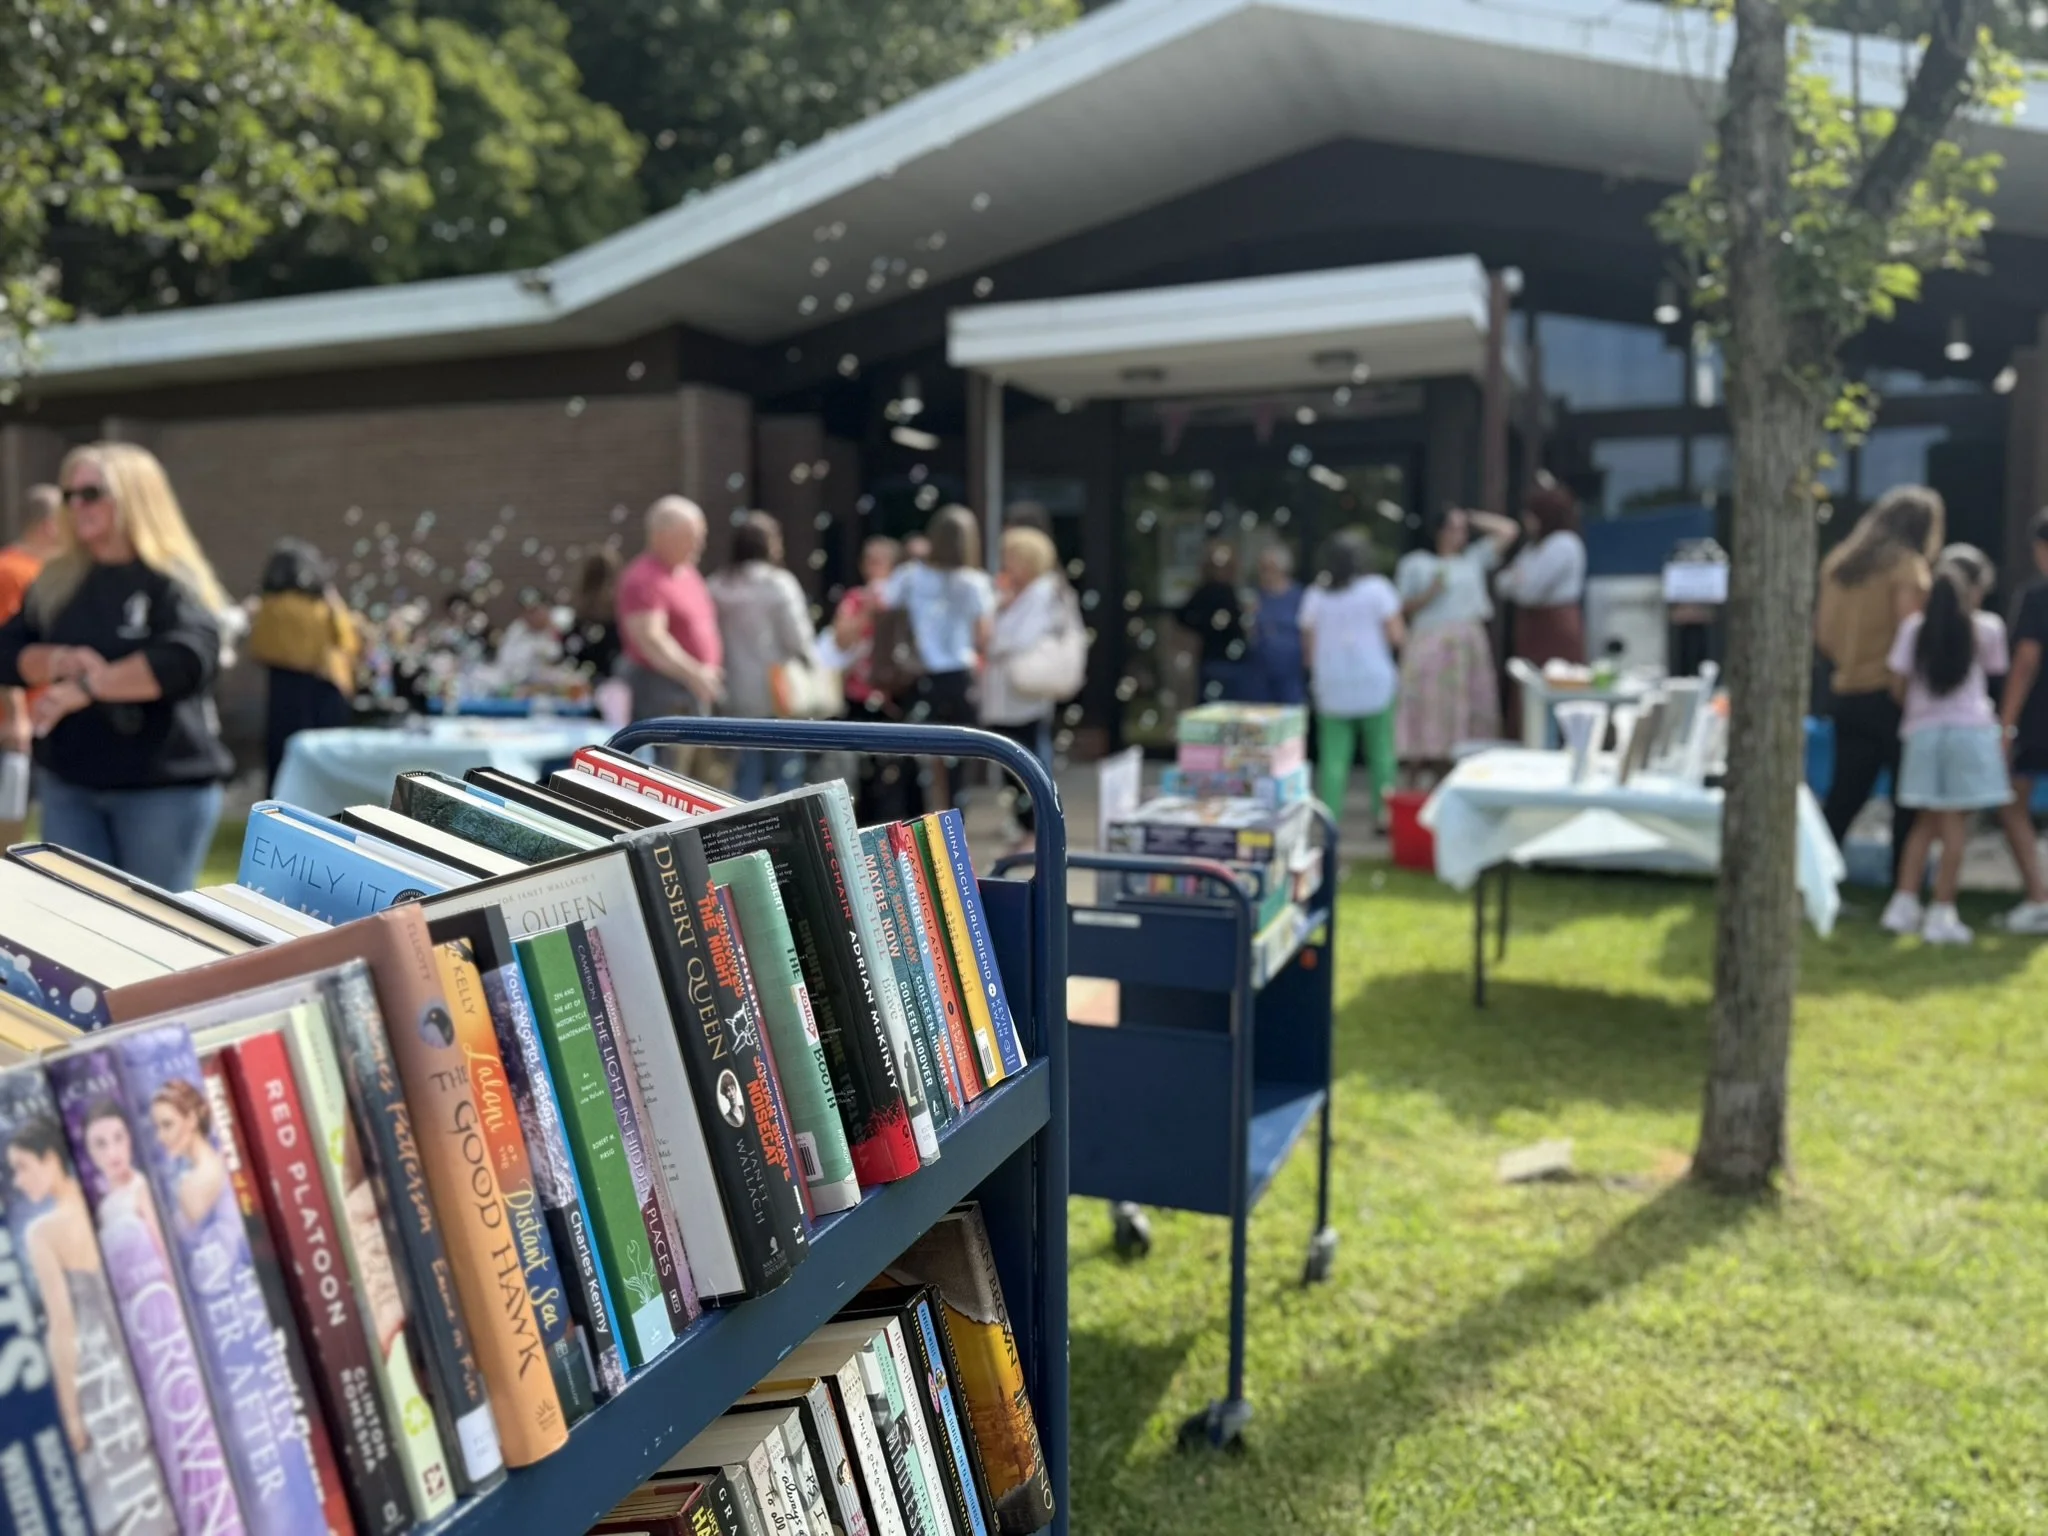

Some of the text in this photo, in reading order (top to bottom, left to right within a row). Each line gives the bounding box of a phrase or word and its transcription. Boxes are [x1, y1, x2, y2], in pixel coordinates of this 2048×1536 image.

[251, 835, 346, 894] EMILY
[706, 880, 718, 908] WE
[764, 861, 785, 912] COLBERT
[819, 817, 852, 921] THE CHAIN
[838, 797, 888, 961] DANIELLE STEEL
[864, 853, 888, 913] MAYBE
[882, 918, 901, 958] NOW
[878, 839, 898, 889] MAYBE
[891, 895, 919, 965] SOMEDAY
[900, 851, 925, 936] NOVEMBER
[944, 815, 992, 981] CHINA RICH GIRLFRIEND
[407, 921, 431, 982] ELLIOTT
[523, 892, 608, 934] QUEEN
[653, 846, 729, 1061] DESERT QUEEN
[697, 895, 732, 988] THE NIGHT
[904, 833, 949, 994] CRAZY RICH ASIANS
[454, 966, 476, 1015] KELLY
[506, 962, 528, 1012] Your
[563, 988, 575, 997] AND
[565, 1003, 574, 1012] ART
[578, 945, 597, 1001] CAMERON
[849, 930, 873, 1004] ADRIAN
[871, 1009, 899, 1089] McKINTY
[882, 978, 898, 1021] Brave
[990, 1001, 1004, 1038] KWAN
[995, 998, 1009, 1036] KEVIN
[556, 1012, 587, 1028] MOTORCYCLE
[558, 1024, 591, 1041] MAINTENANCE
[787, 947, 801, 981] THE
[812, 1048, 837, 1110] BOOTH
[899, 981, 934, 1088] COLLEEN HOOVER
[915, 975, 950, 1085] COLLEEN HOOVER
[928, 972, 955, 1074] COLLEEN HOOVER
[950, 1023, 966, 1062] KWAN
[954, 1021, 968, 1060] KEVIN
[204, 1074, 242, 1172] Killers
[429, 1065, 468, 1092] THE
[463, 1042, 504, 1134] Lalani
[747, 1079, 780, 1167] NOISECAT
[385, 1101, 433, 1235] Patterson
[594, 1013, 610, 1042] THE
[603, 1046, 627, 1104] LIGHT
[620, 1106, 631, 1126] IN
[626, 1129, 660, 1203] HIDDEN
[645, 1207, 673, 1277] PLACES
[736, 1138, 767, 1225] WALLACH
[748, 1150, 769, 1201] JANET
[265, 1078, 348, 1328] RED PLATOON
[448, 1100, 541, 1381] GOOD HAWK
[502, 1189, 560, 1331] Distant Sea
[571, 1210, 609, 1333] Charles Kenny
[234, 1265, 301, 1443] HAPPILY
[431, 1258, 456, 1320] Emma
[459, 1355, 479, 1401] Fire
[938, 1299, 974, 1430] NICHOLAS SPARKS
[989, 1280, 1018, 1368] BROWN
[130, 1282, 240, 1536] CROWN
[193, 1242, 287, 1501] EVER AFTER
[353, 1366, 388, 1461] CLINTON
[73, 1355, 163, 1536] HEIR
[340, 1369, 377, 1474] ROMESHA
[858, 1411, 890, 1515] WHITE OLEANDER
[949, 1417, 960, 1445] SECRETS
[1015, 1386, 1053, 1510] INFERNO
[741, 1483, 750, 1509] THE
[771, 1512, 786, 1532] all
[782, 1476, 802, 1526] always
[919, 1485, 929, 1510] THE
